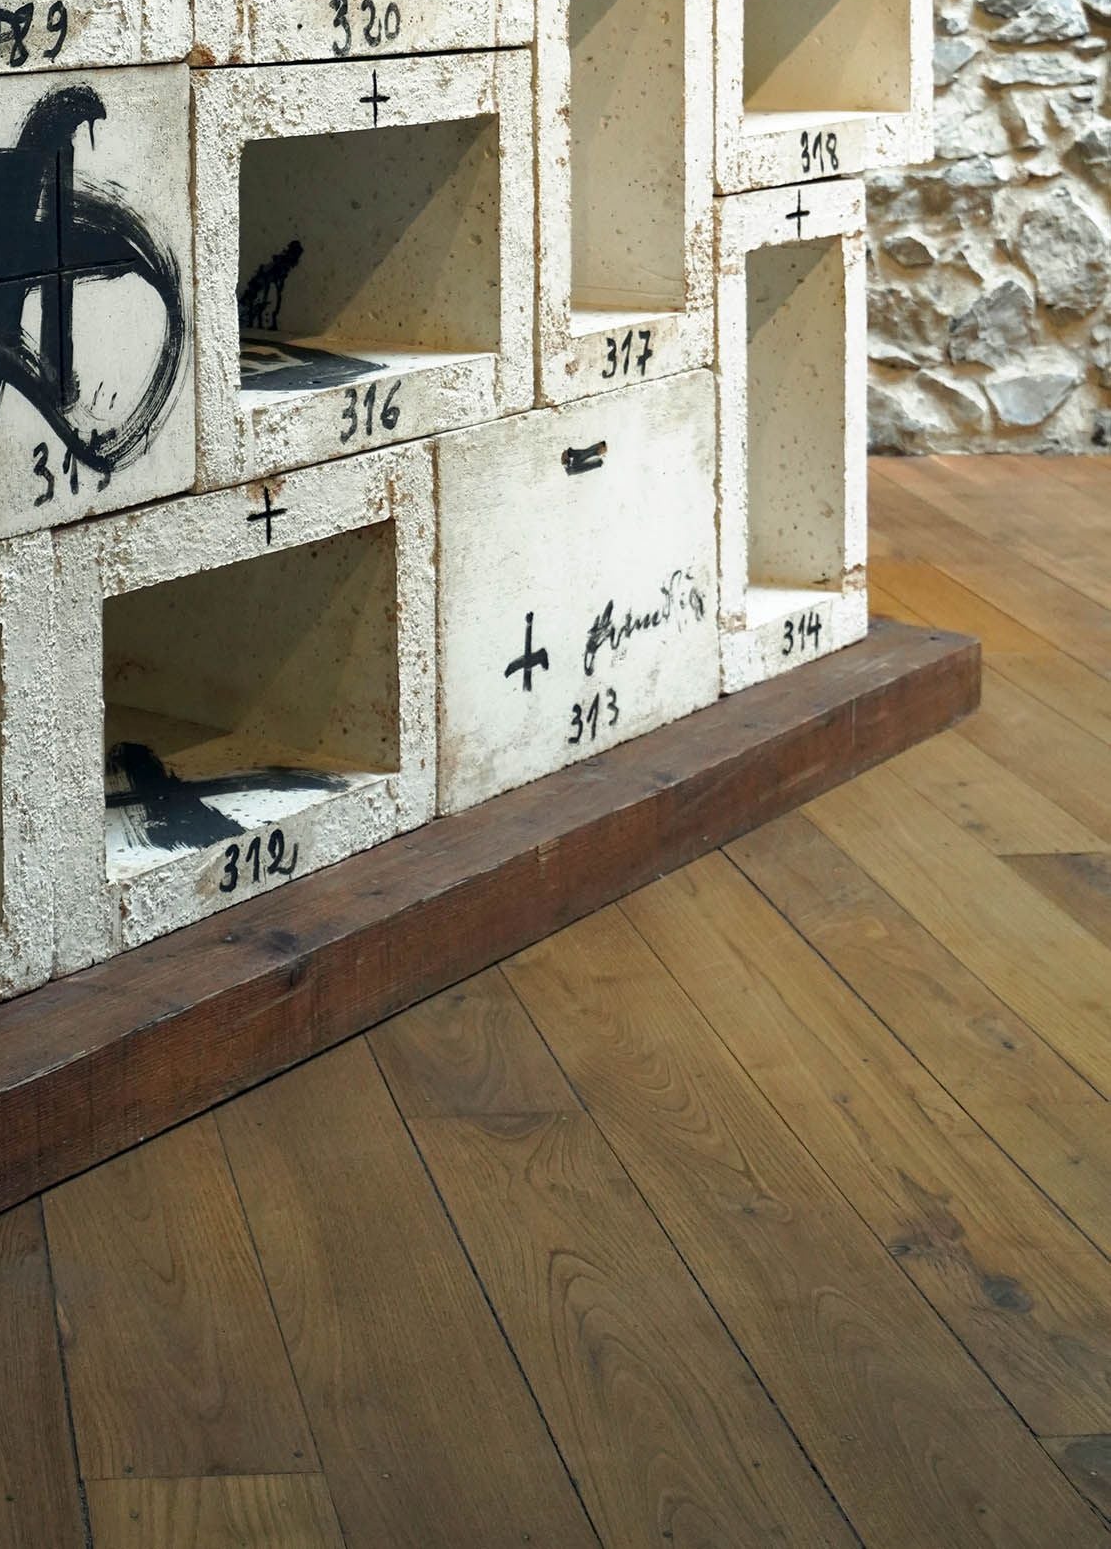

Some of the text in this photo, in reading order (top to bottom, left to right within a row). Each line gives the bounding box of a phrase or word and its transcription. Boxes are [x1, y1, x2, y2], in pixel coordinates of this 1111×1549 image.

[799, 130, 840, 175] 318
[601, 327, 655, 380] 317
[339, 379, 403, 445] 316
[781, 608, 824, 656] 314
[566, 687, 620, 745] 313
[218, 828, 299, 893] 312
